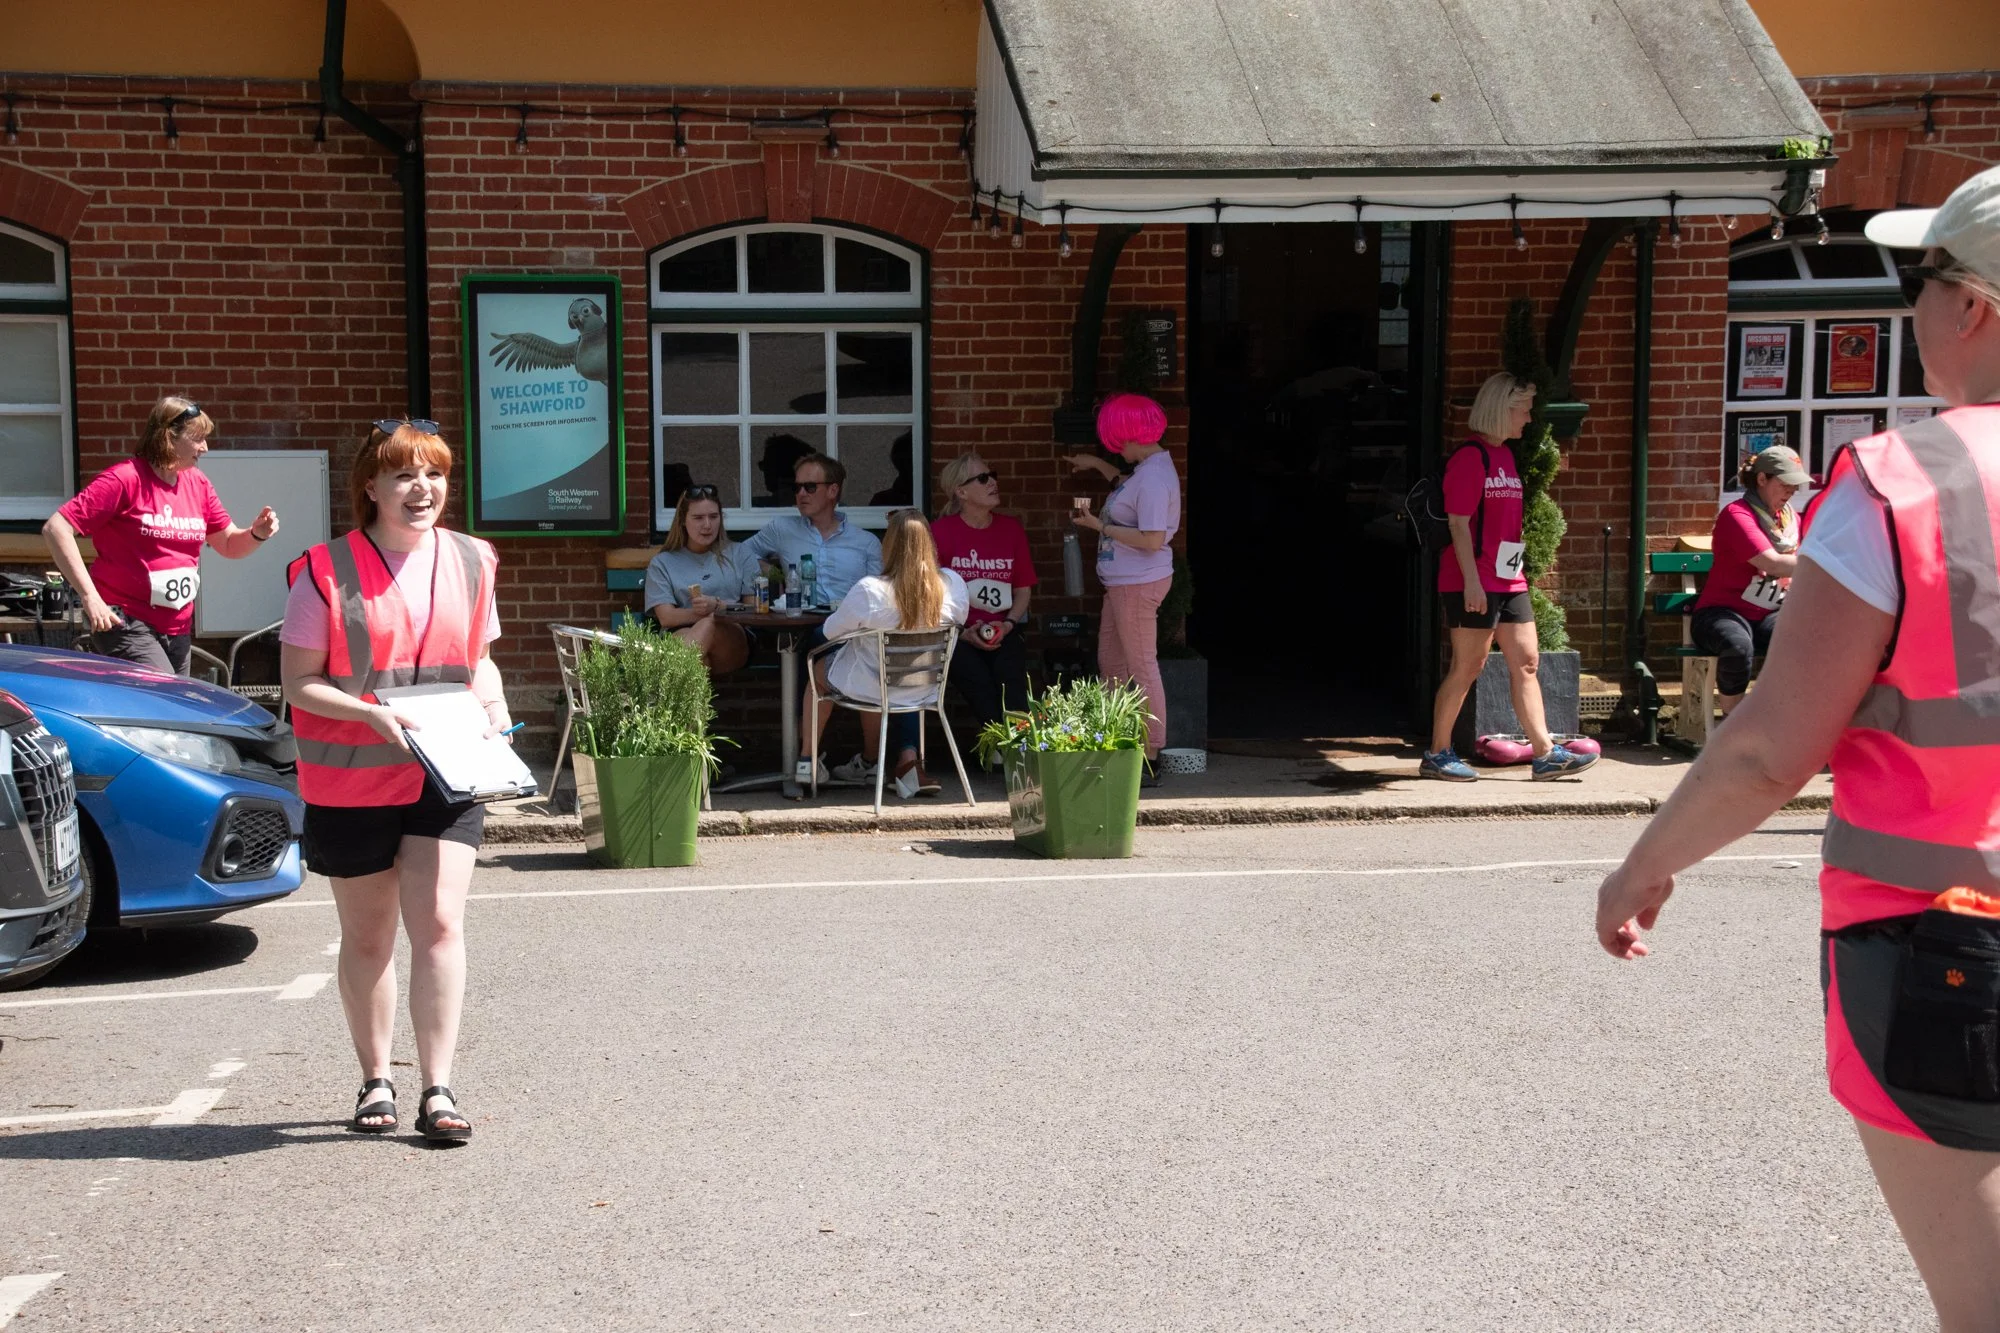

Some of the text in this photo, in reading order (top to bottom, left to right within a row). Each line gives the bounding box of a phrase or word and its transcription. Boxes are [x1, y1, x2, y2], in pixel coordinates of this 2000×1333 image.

[1747, 335, 1771, 343] MISSING
[490, 380, 589, 400] WELCOME TO
[500, 396, 586, 416] SHAWFORD
[557, 416, 598, 425] INFORMATION.
[1484, 467, 1523, 489] AGAINS
[548, 488, 599, 497] South Western
[555, 496, 583, 504] Railway
[548, 503, 566, 511] Spread
[140, 526, 175, 539] breast
[951, 549, 1014, 570] AGAINST
[1506, 552, 1521, 572] 4
[957, 569, 1012, 580] reast cancer
[165, 576, 191, 602] 86
[977, 586, 1002, 607] 43
